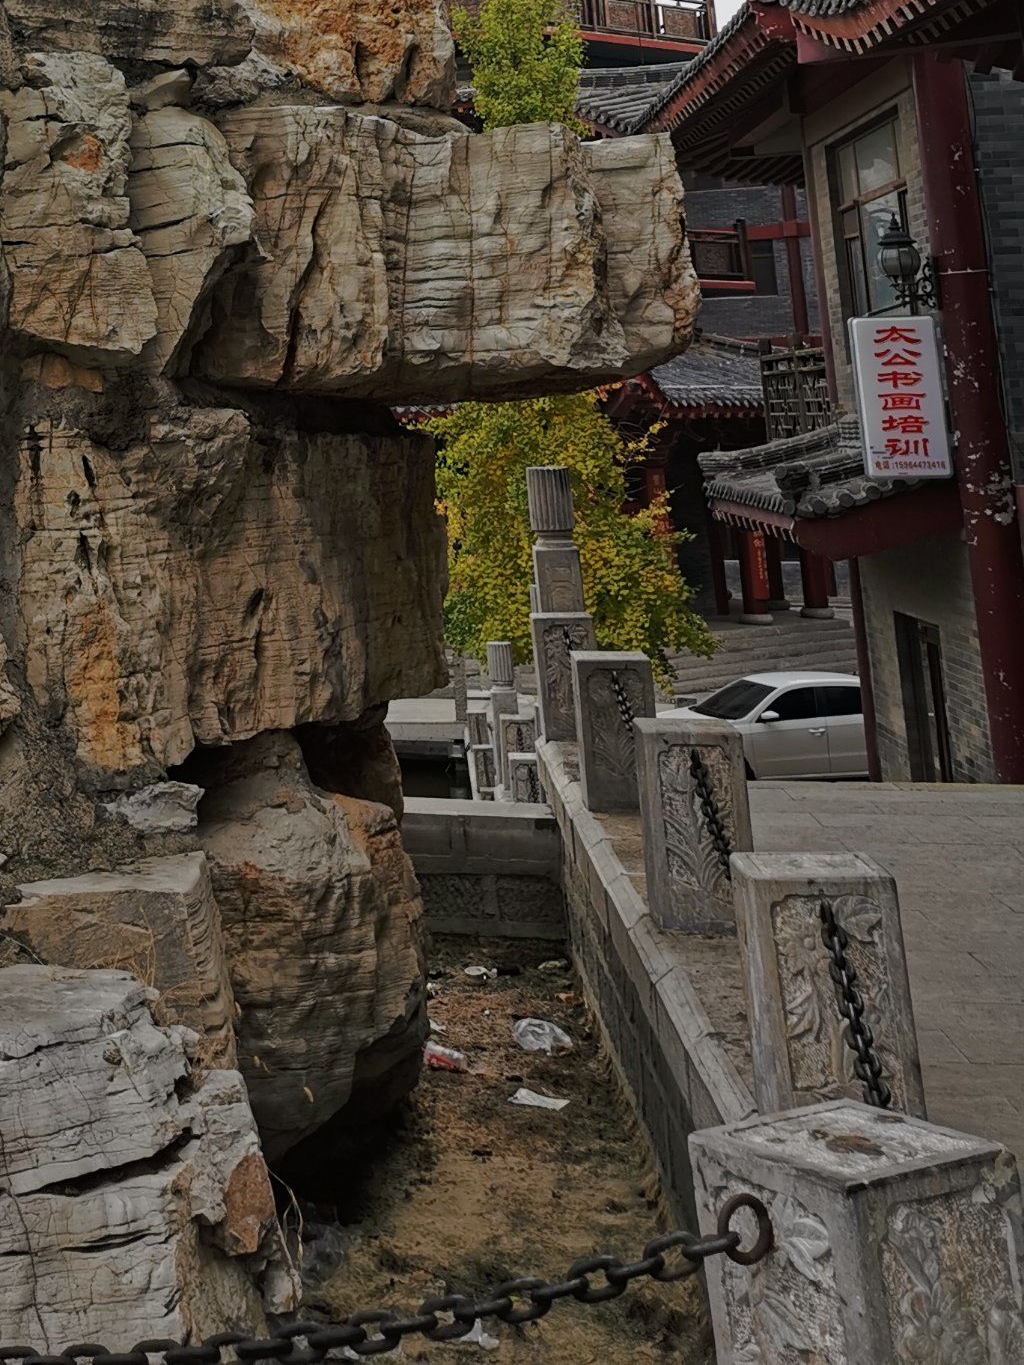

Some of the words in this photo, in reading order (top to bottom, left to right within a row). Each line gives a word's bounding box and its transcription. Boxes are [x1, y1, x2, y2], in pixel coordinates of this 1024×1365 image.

[874, 326, 929, 457] 太公书画培训
